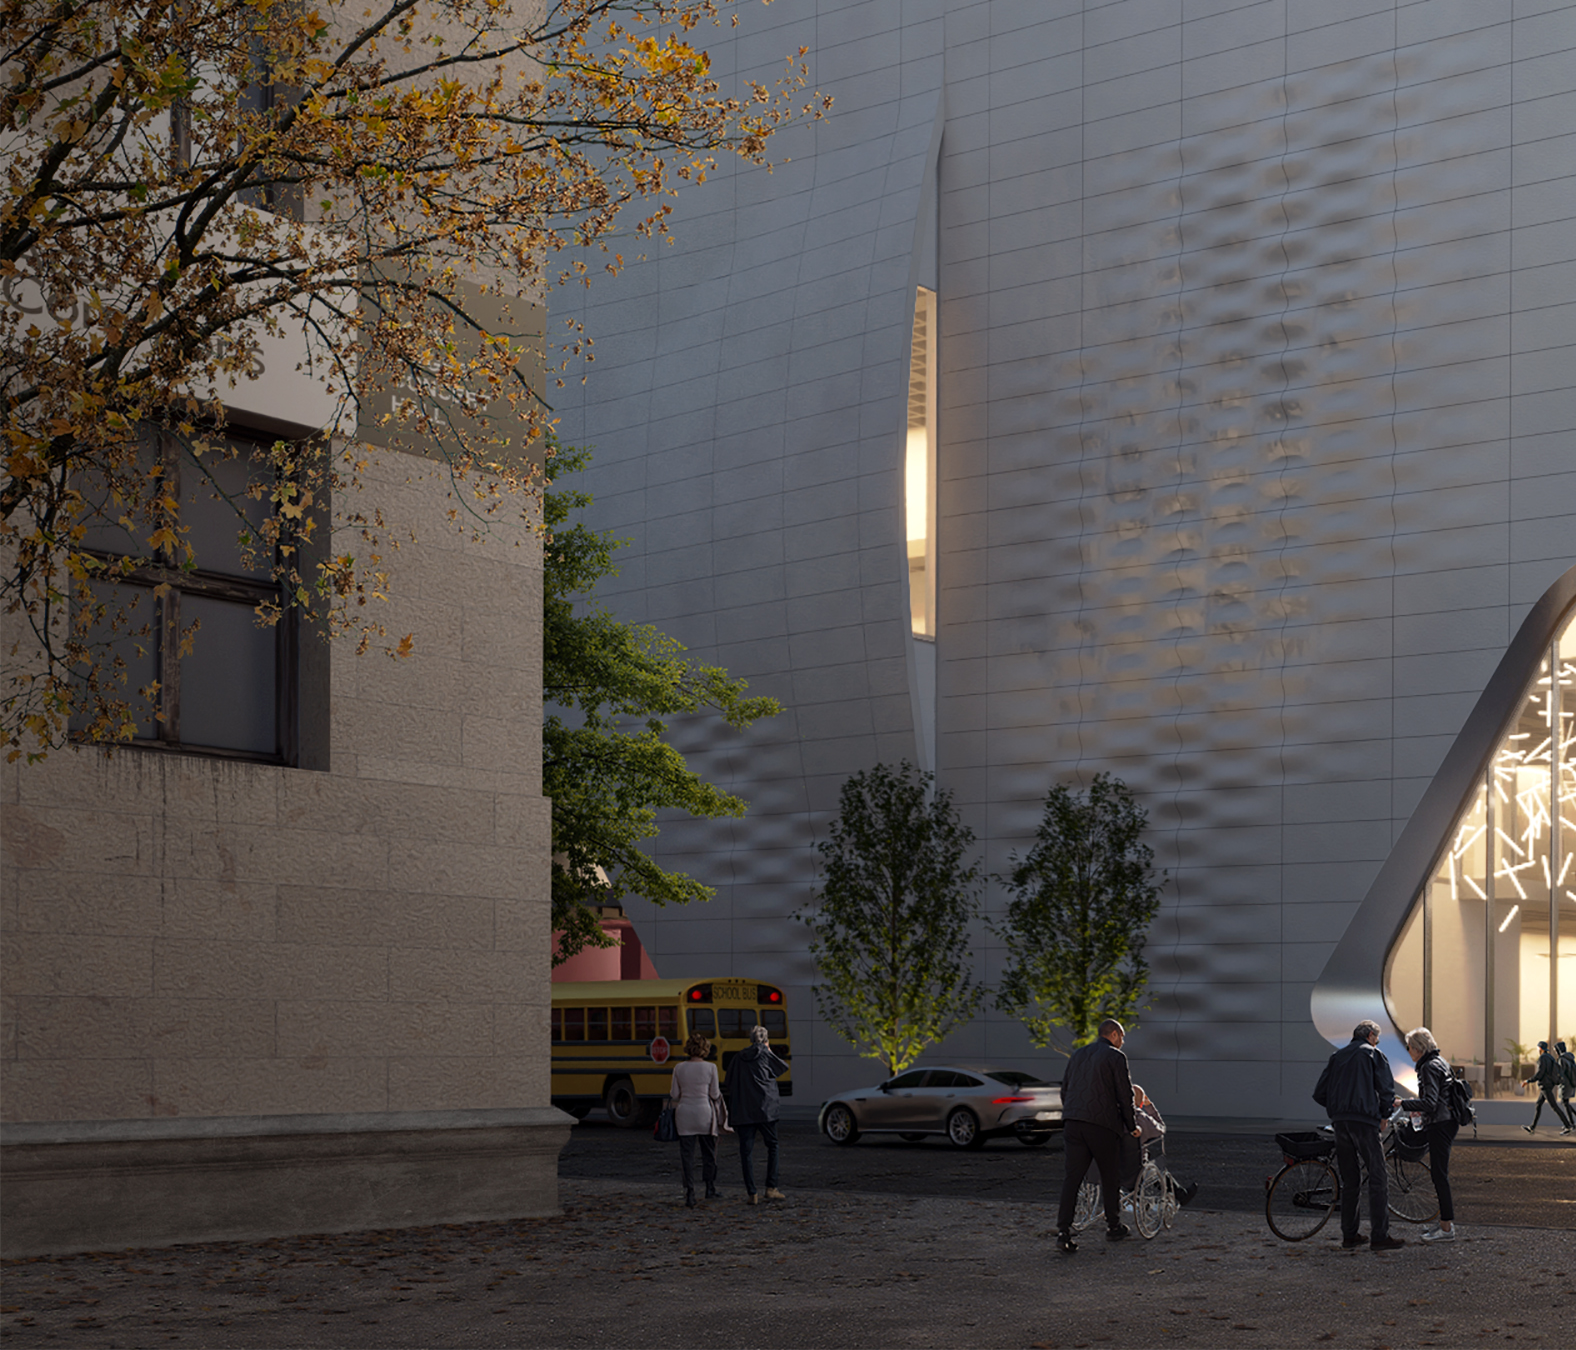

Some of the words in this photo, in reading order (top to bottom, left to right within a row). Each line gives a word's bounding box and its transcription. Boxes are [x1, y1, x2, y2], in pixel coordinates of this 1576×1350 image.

[713, 986, 741, 1000] SCHOOL
[742, 987, 756, 1000] BUS
[652, 1045, 668, 1055] STOP
